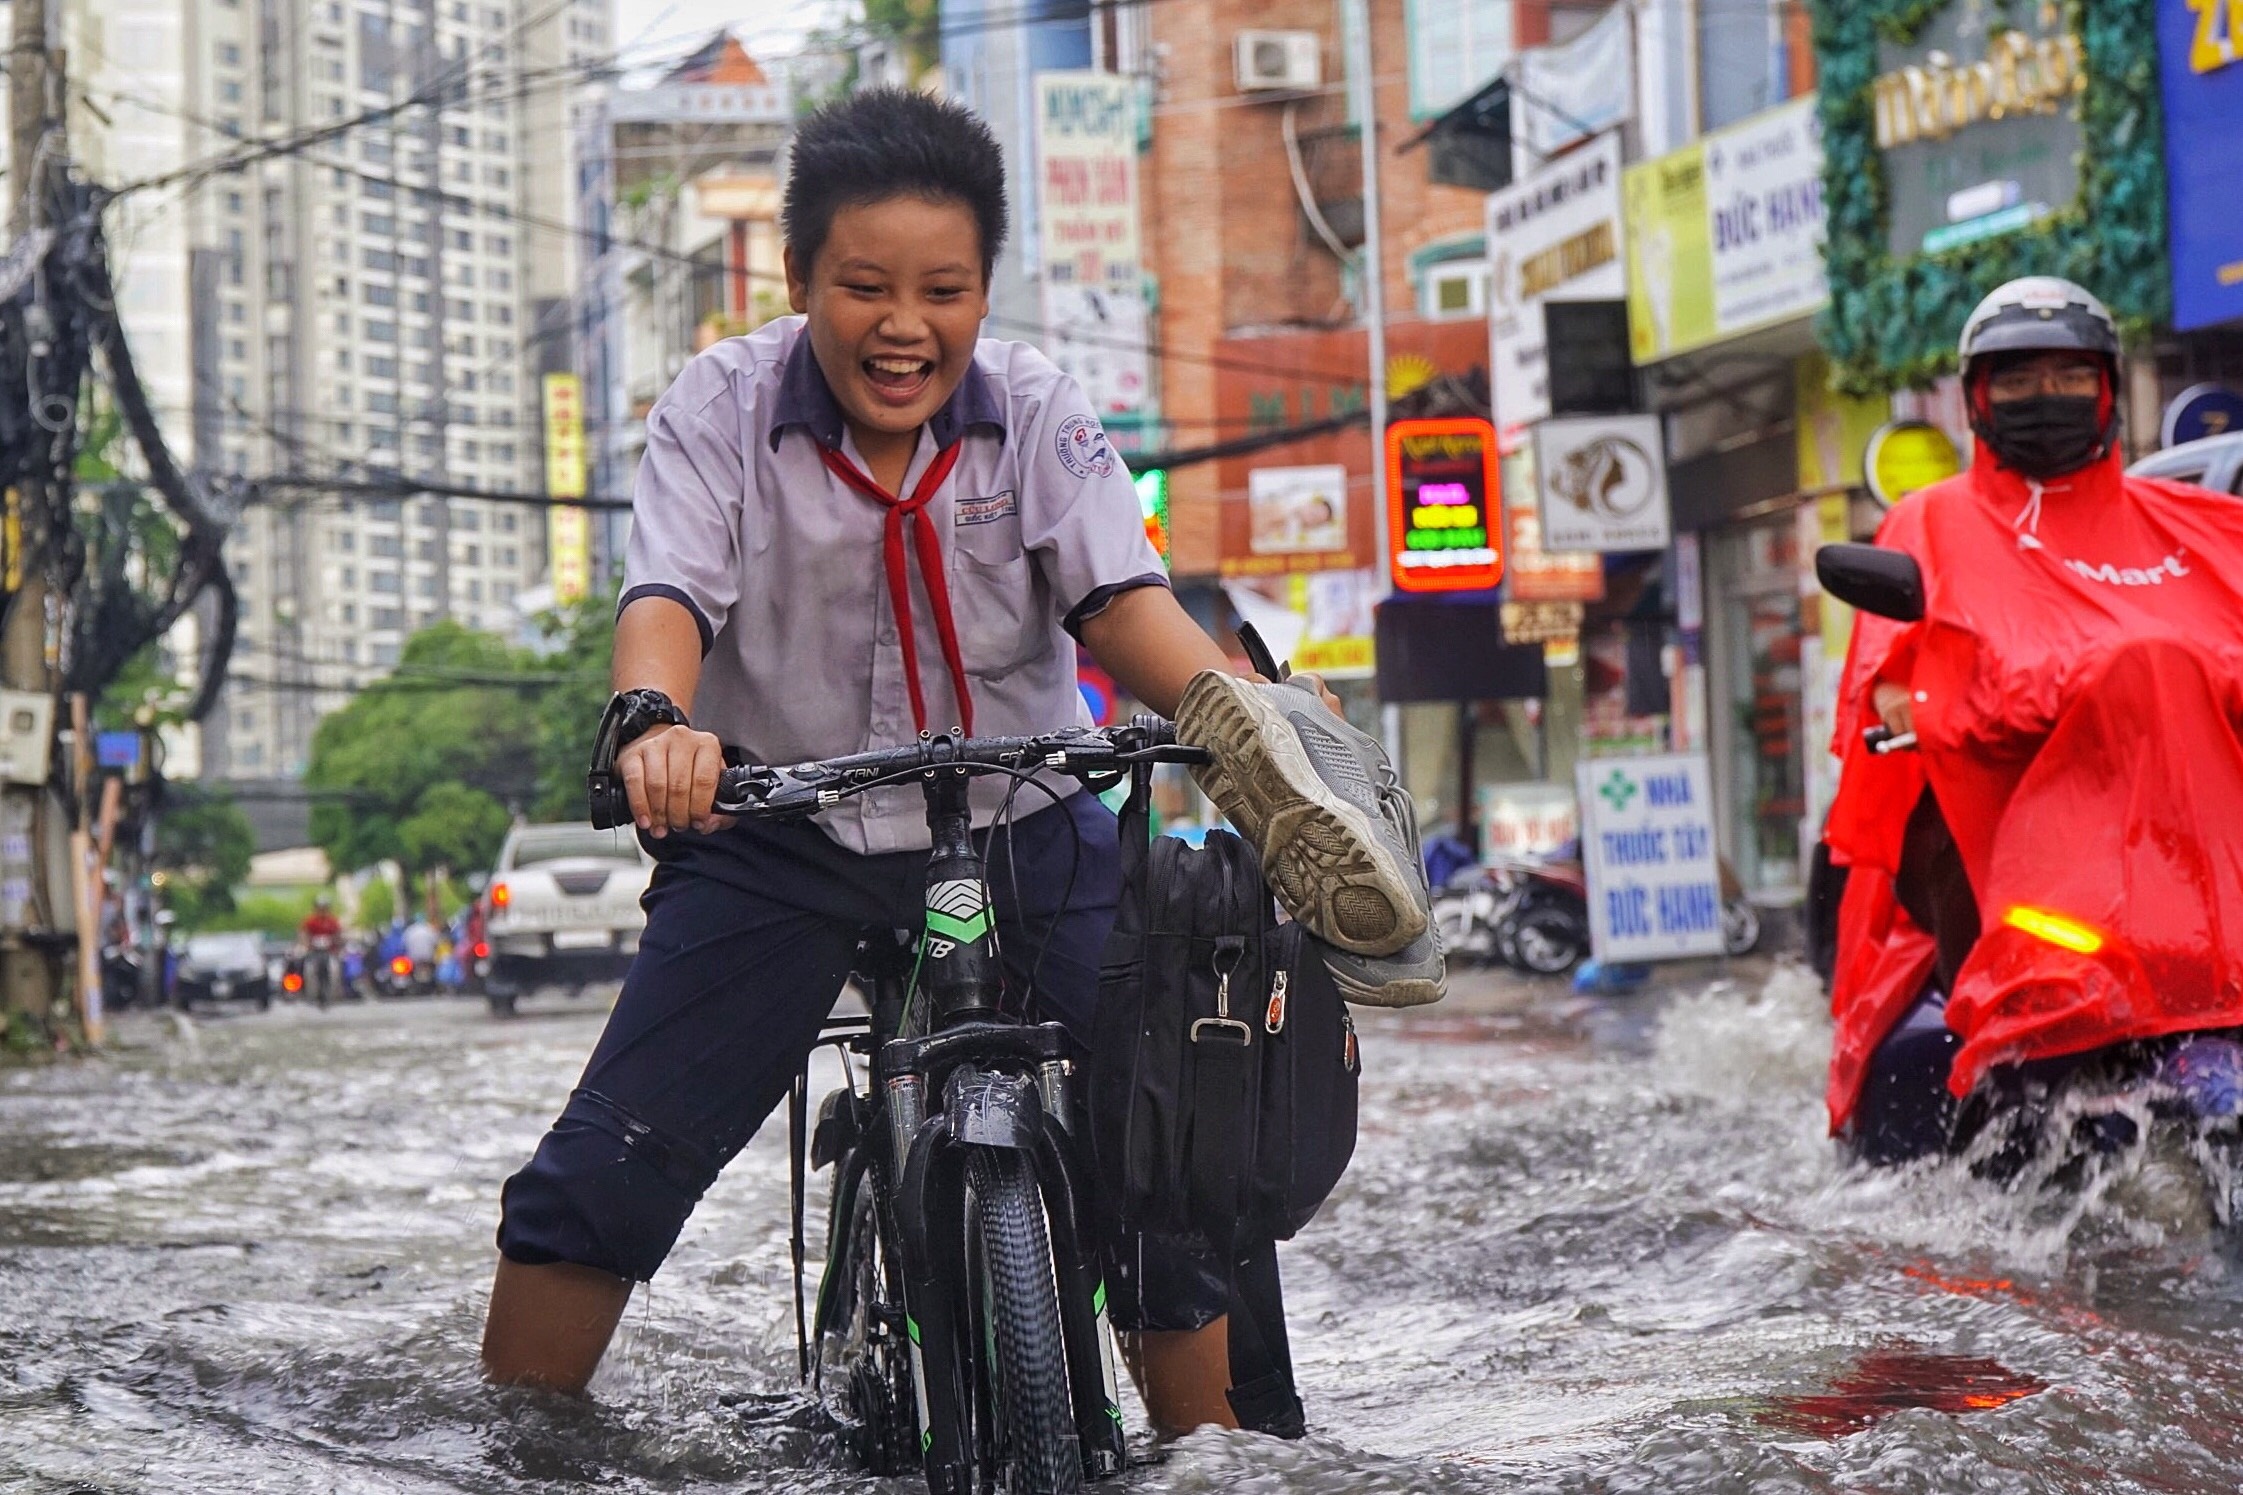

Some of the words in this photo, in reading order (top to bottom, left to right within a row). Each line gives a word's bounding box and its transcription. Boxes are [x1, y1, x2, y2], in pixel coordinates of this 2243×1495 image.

[2064, 554, 2191, 586] Mart
[1645, 768, 1692, 806] NHÀ
[1602, 820, 1667, 866] THUỐC
[1671, 822, 1709, 860] TÂY
[1606, 878, 1651, 939] ĐỨC
[1656, 881, 1716, 946] HẠNH
